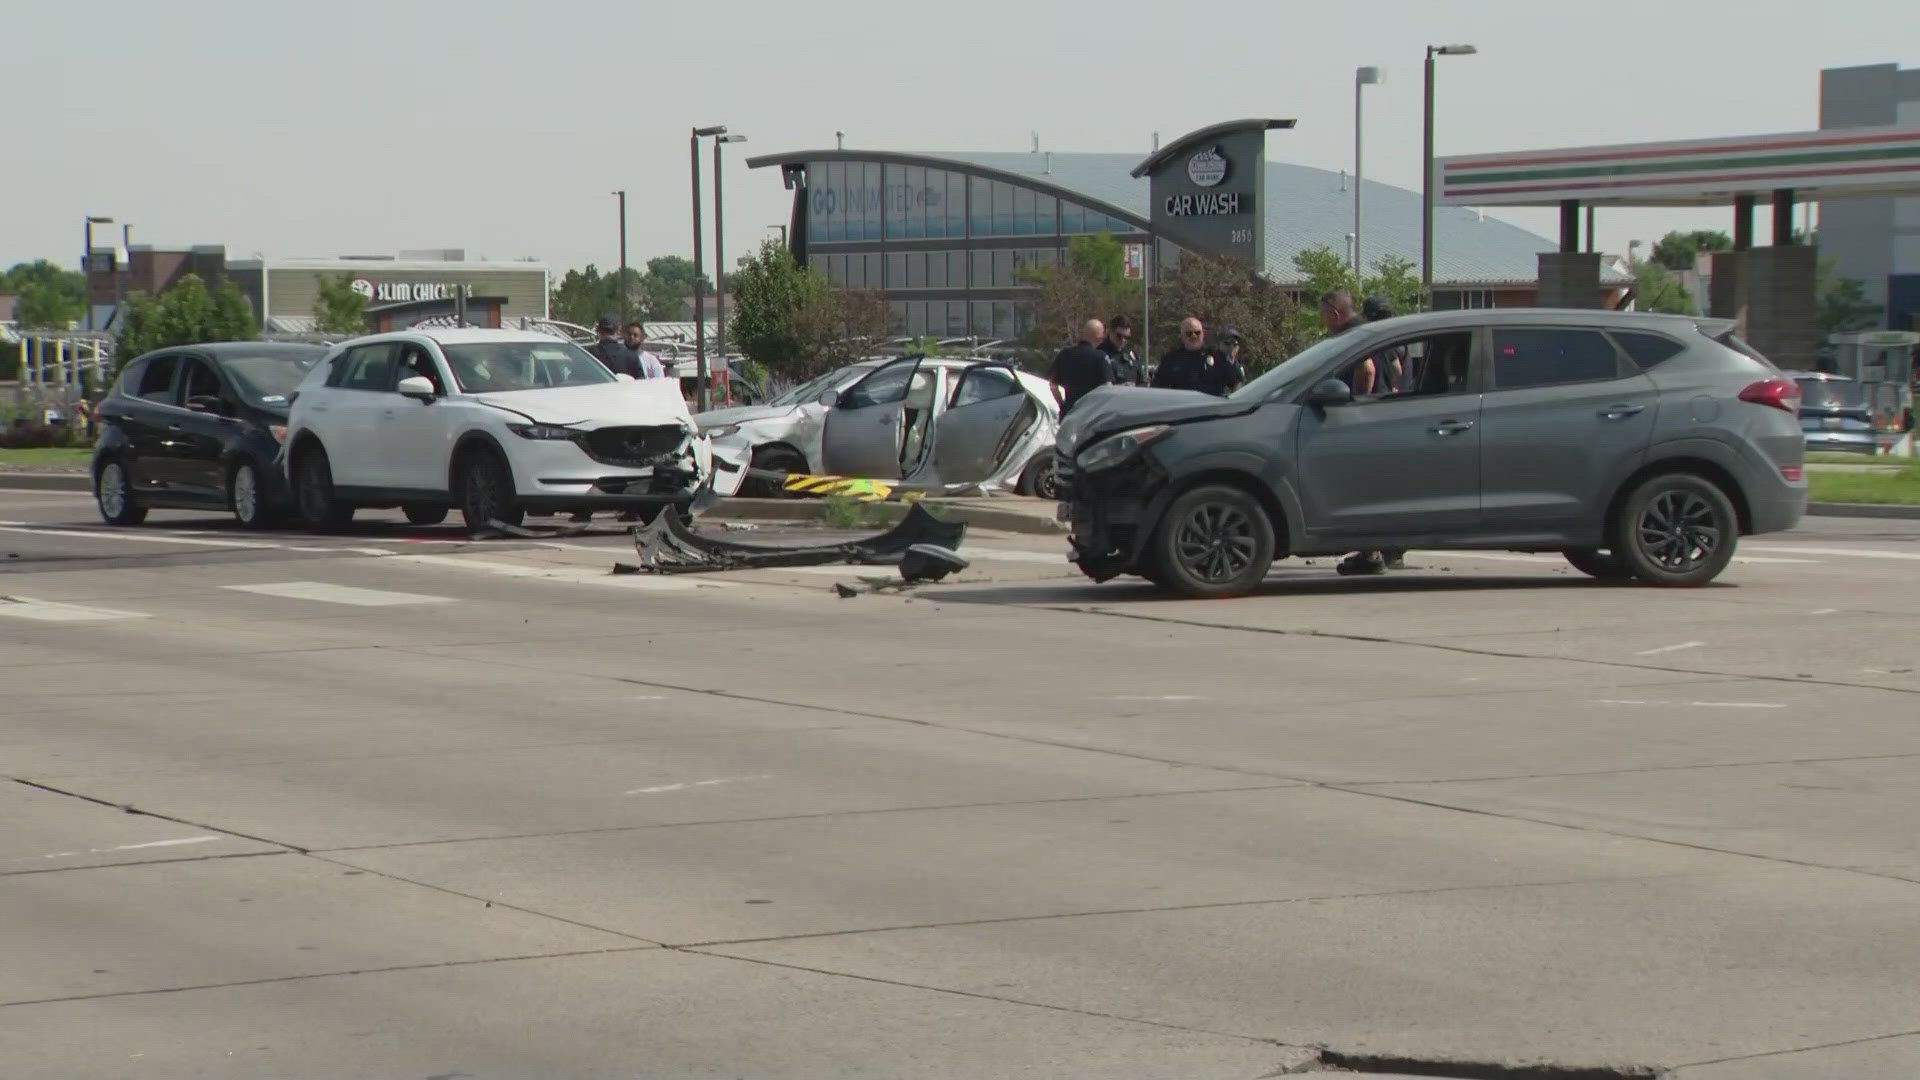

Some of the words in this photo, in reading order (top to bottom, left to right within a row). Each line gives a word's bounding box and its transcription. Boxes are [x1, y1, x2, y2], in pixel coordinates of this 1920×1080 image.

[813, 188, 836, 215] GO
[1165, 194, 1192, 216] CAR
[1195, 192, 1239, 214] WASH
[378, 283, 411, 300] SLIM
